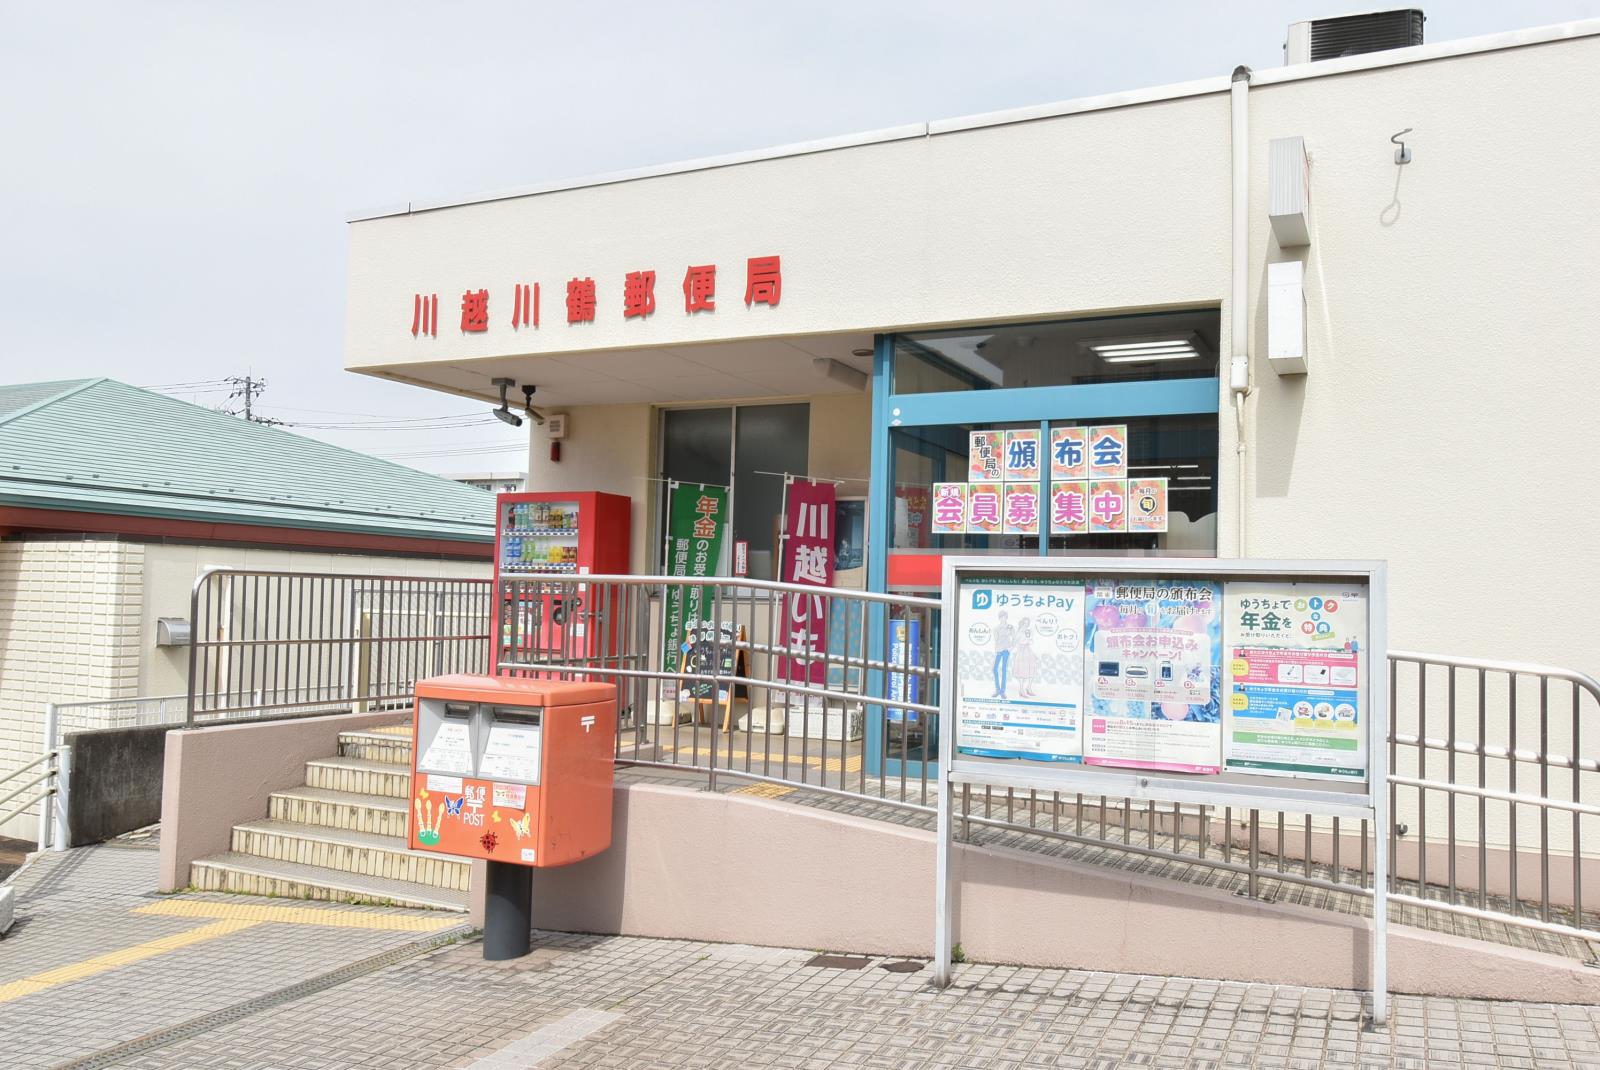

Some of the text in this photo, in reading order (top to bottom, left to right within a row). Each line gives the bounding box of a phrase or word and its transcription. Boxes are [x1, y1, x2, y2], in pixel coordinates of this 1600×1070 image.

[411, 255, 782, 337] 川越川鶴郵便局
[973, 435, 1123, 478] 郵便局の 頒布会
[935, 491, 1124, 525] 会員募集中
[1116, 587, 1212, 600] 郵便局の頒布会
[996, 593, 1075, 612] ゆうちょPay
[1239, 599, 1292, 610] ゆうちょで
[1240, 611, 1293, 631] 年金を
[1106, 634, 1198, 651] 頒布会お申込み
[1122, 650, 1182, 660] キャンペーン!
[464, 785, 486, 802] 郵便
[463, 812, 485, 827] POST
